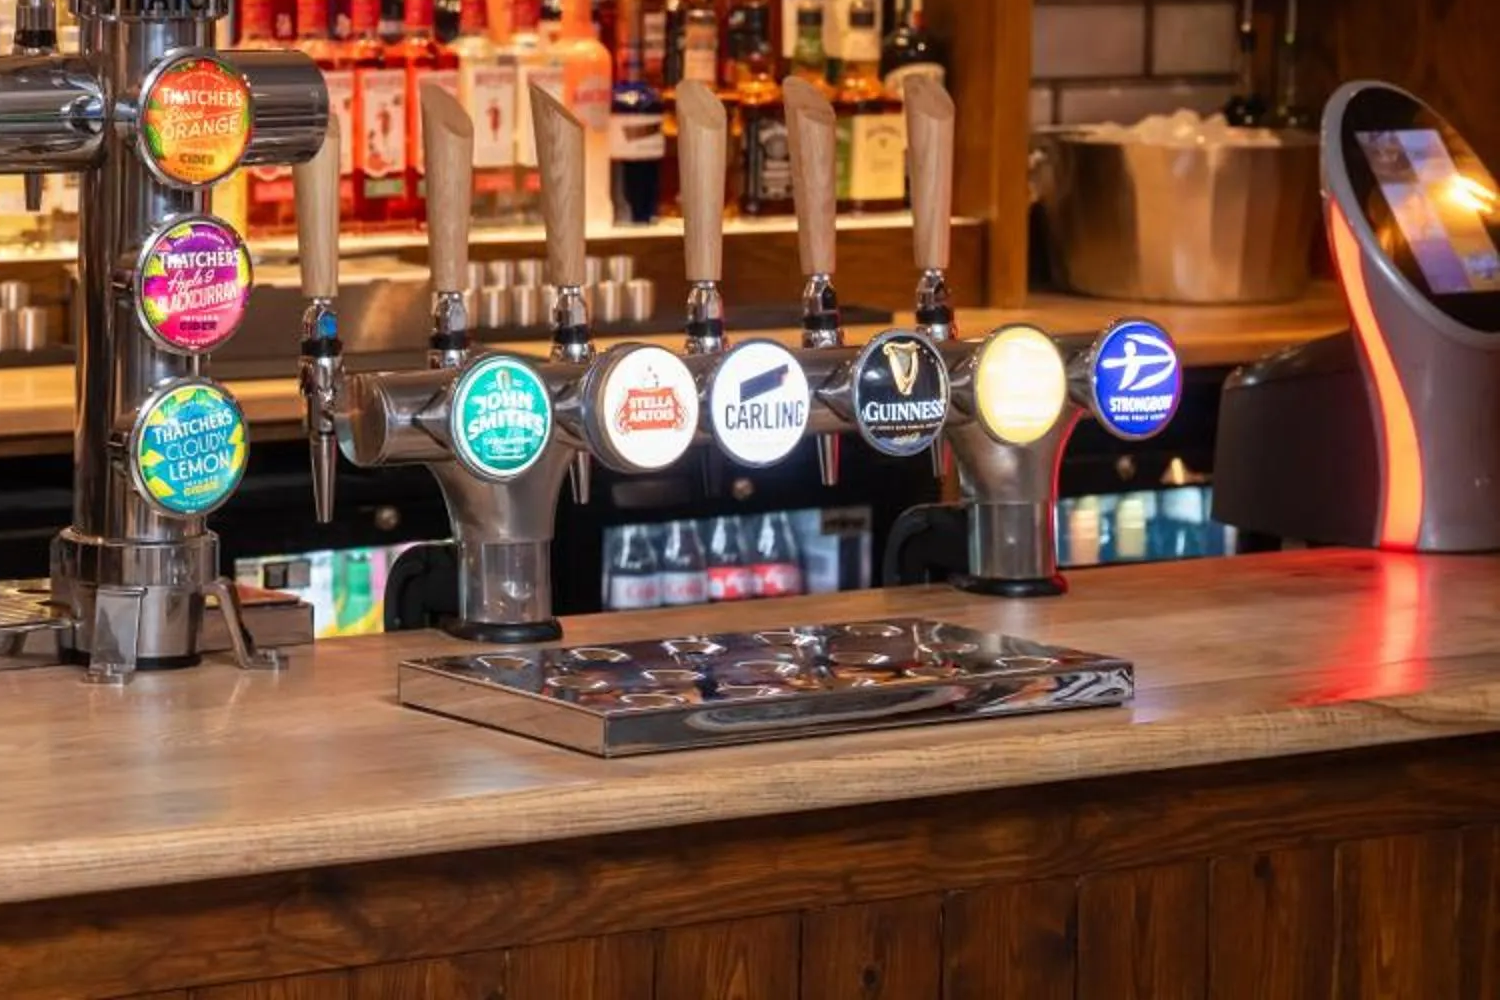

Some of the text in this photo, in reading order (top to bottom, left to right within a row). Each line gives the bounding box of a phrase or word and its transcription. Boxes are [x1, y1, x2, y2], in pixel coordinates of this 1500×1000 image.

[161, 87, 243, 107] THATCHERS
[159, 113, 240, 142] ORANGE
[158, 249, 241, 269] THATCHERS
[471, 390, 534, 415] JOHN
[628, 395, 675, 410] STELLA
[725, 400, 805, 430] CARLING
[865, 400, 945, 421] GUINNESS
[1109, 395, 1173, 413] STRONGBOW
[152, 407, 233, 445] THATCHERS
[467, 410, 545, 441] SMITH'S
[628, 409, 675, 422] ARTOIS
[165, 430, 228, 461] CLOUDY
[169, 449, 231, 481] LEMON
